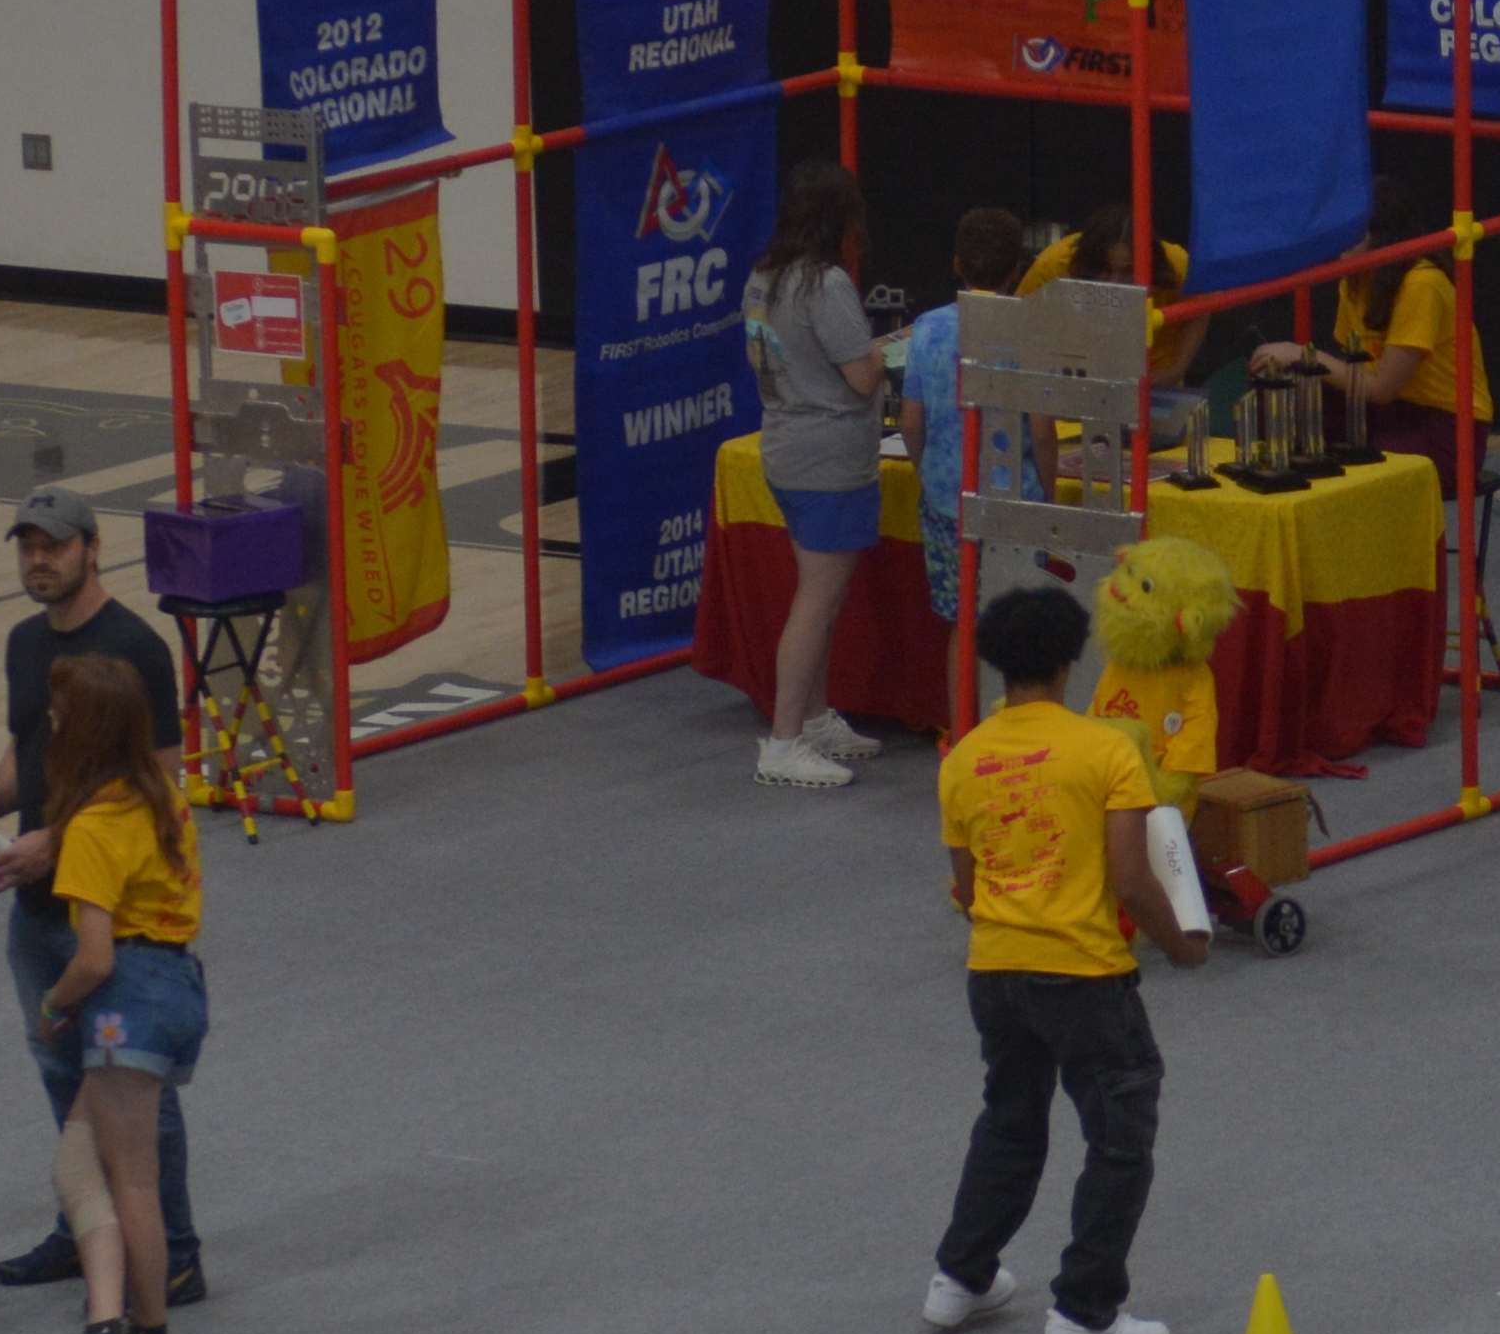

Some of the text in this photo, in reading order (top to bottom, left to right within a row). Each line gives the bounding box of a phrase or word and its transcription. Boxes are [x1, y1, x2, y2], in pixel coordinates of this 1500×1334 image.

[317, 12, 383, 51] 2012
[629, 24, 736, 72] REGIONAL
[289, 45, 427, 100] COLORADO
[301, 83, 417, 129] GIONAL
[636, 247, 728, 322] FRC
[346, 267, 384, 605] COUGARS GONE WIRED
[623, 383, 733, 447] WINNER
[659, 508, 703, 545] 2014
[619, 575, 702, 619] REGION
